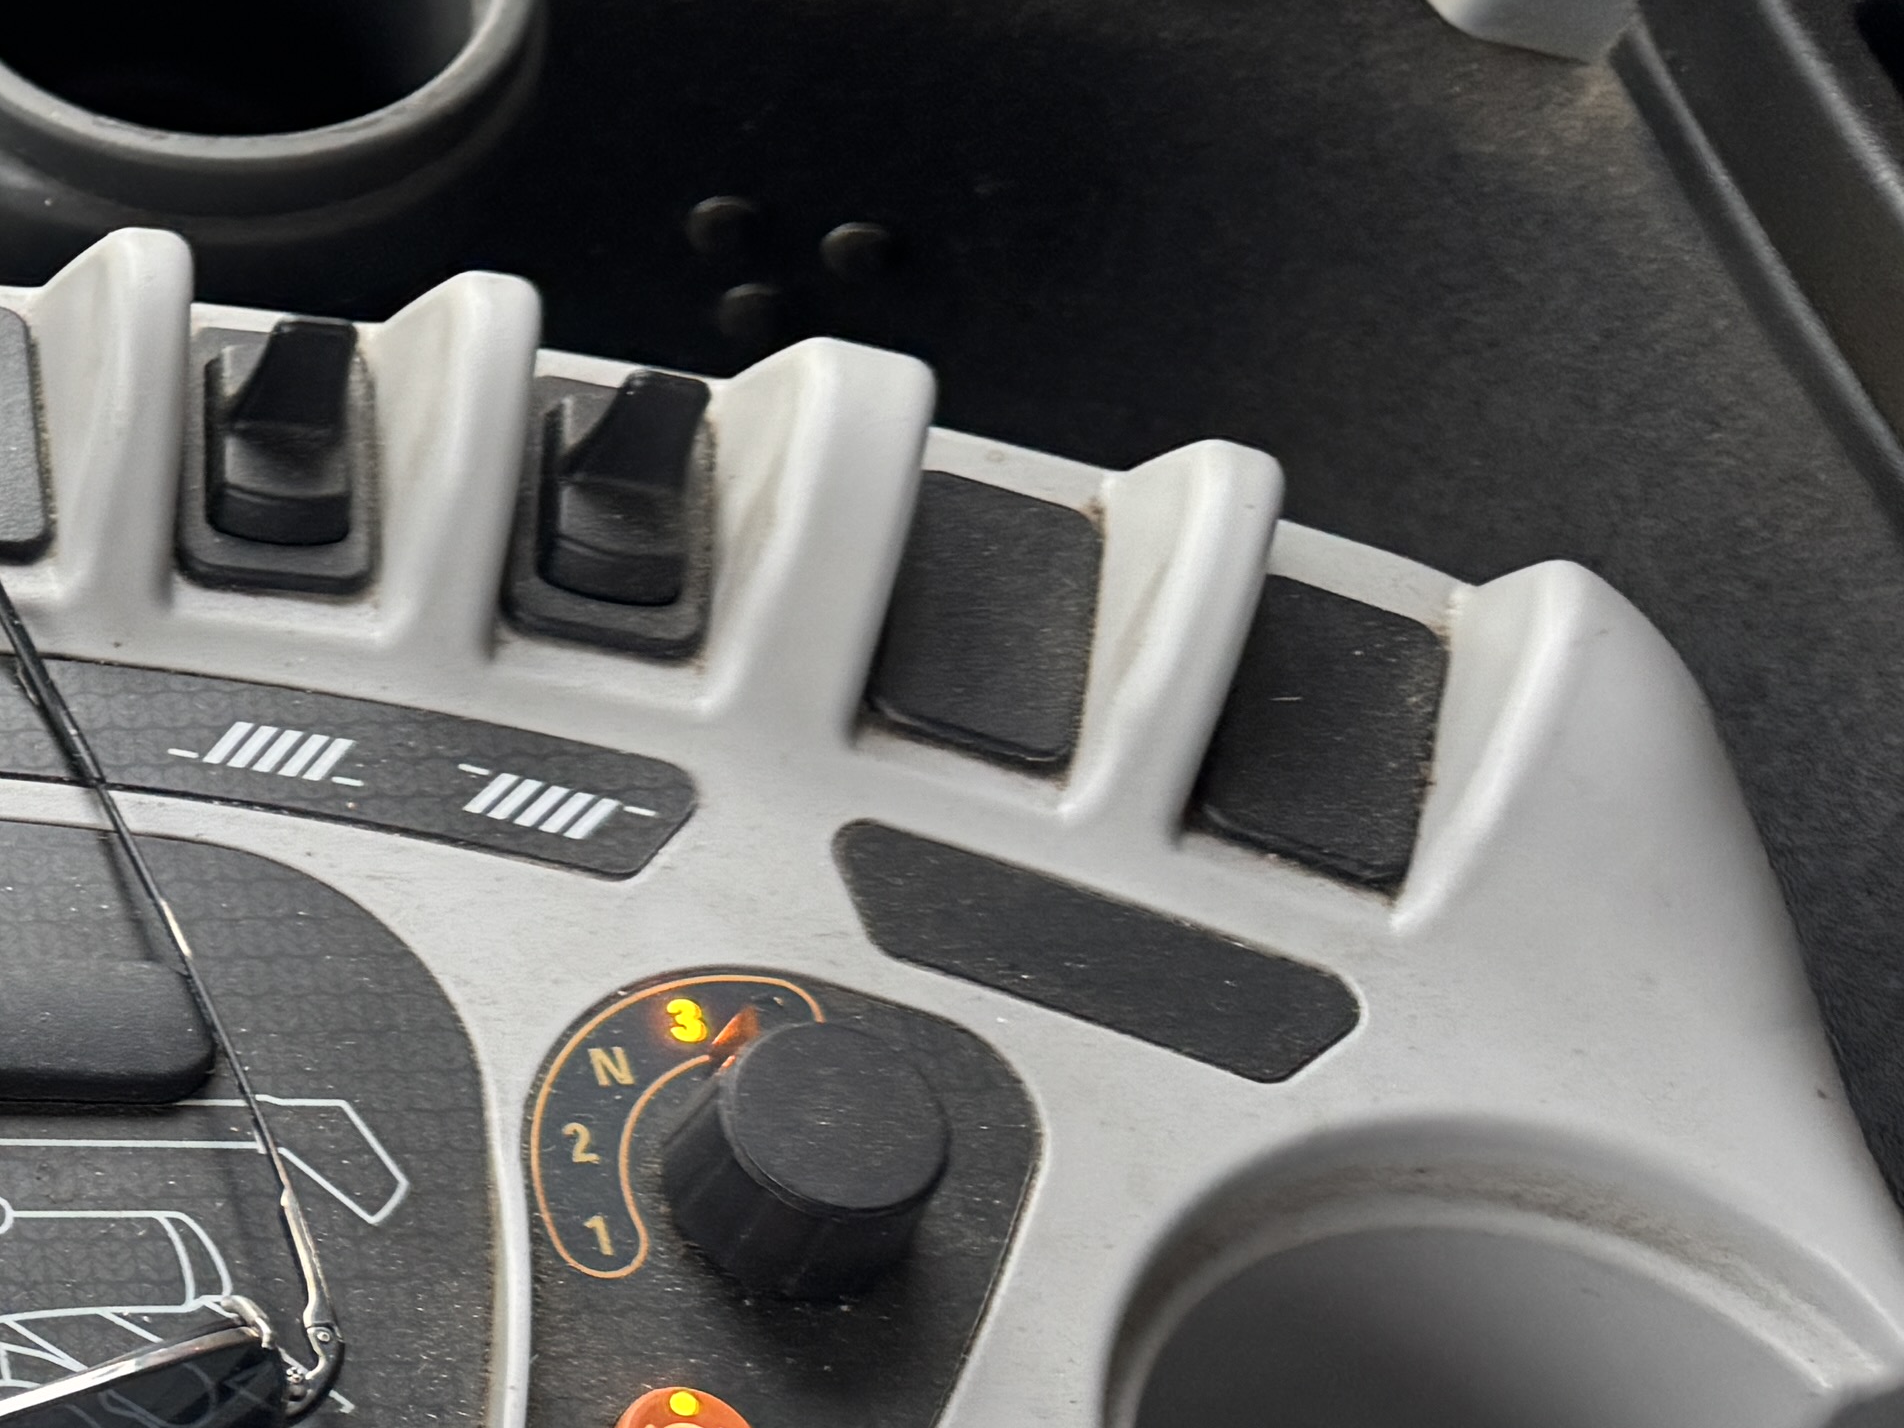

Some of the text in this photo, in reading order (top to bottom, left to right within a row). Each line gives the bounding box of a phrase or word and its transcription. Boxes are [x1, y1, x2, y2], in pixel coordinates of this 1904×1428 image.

[665, 998, 709, 1044] 3
[588, 1046, 635, 1086] N
[562, 1123, 601, 1163] 2
[584, 1215, 615, 1256] 1
